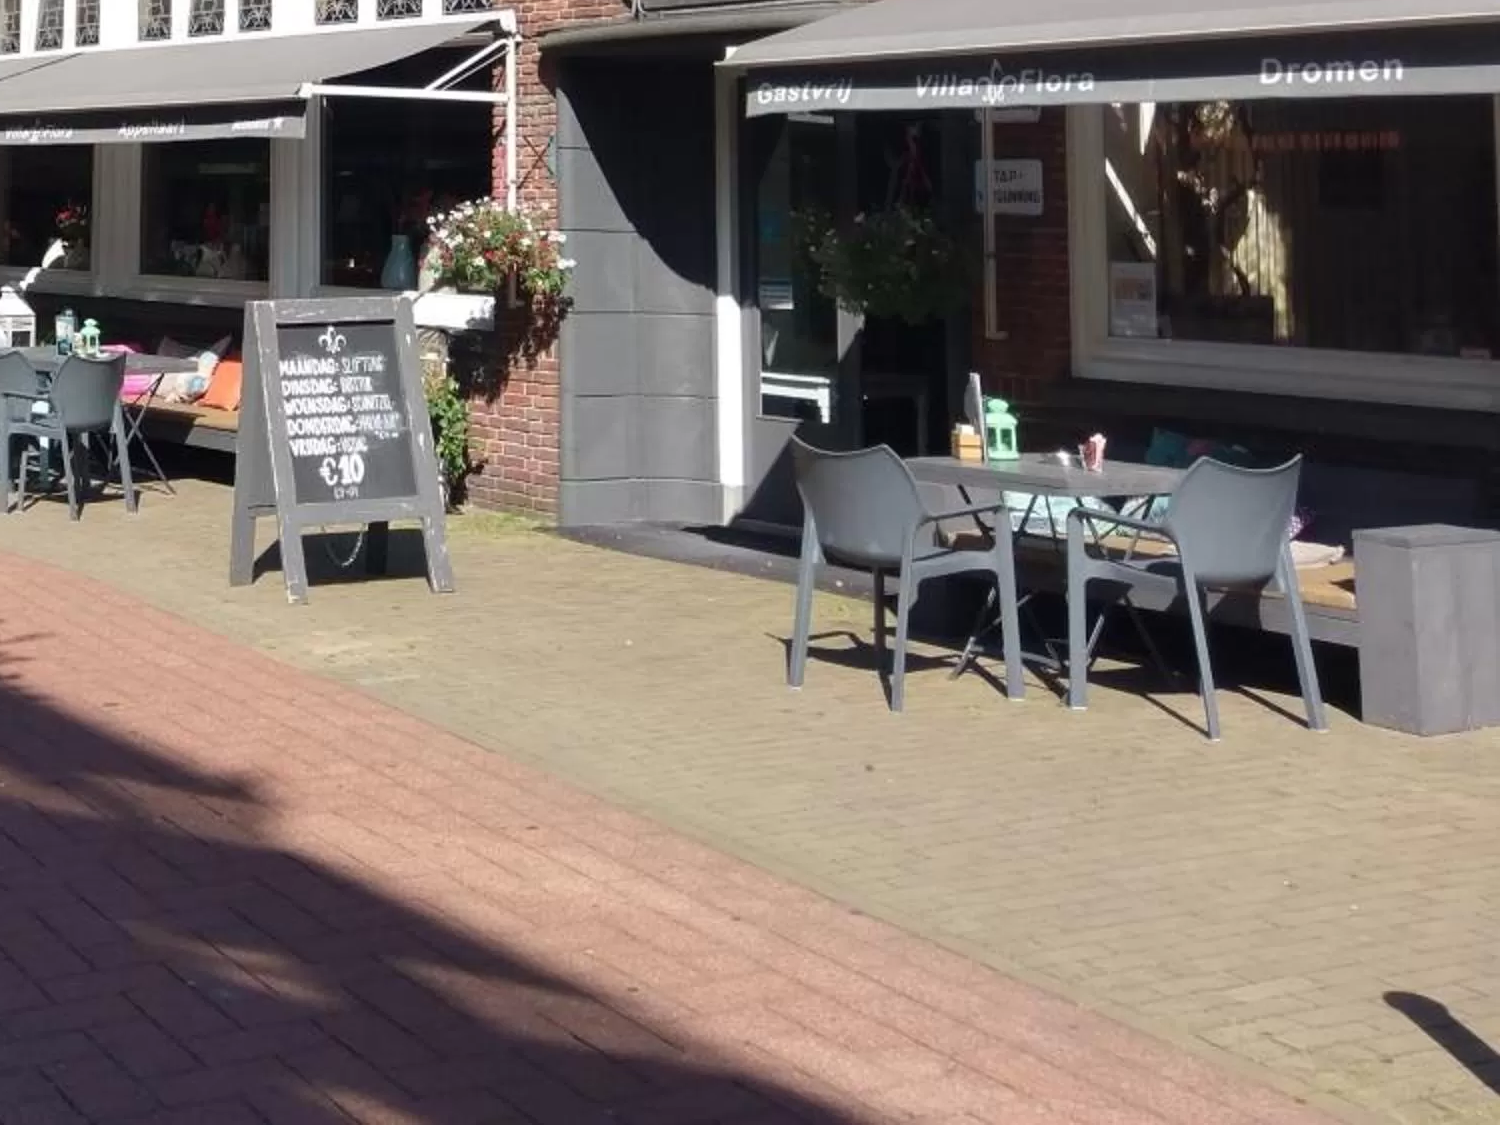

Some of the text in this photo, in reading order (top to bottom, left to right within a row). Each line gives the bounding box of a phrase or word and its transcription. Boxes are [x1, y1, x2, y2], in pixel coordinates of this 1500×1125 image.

[756, 58, 1404, 104] Gastvrij Villa Flora Dromen
